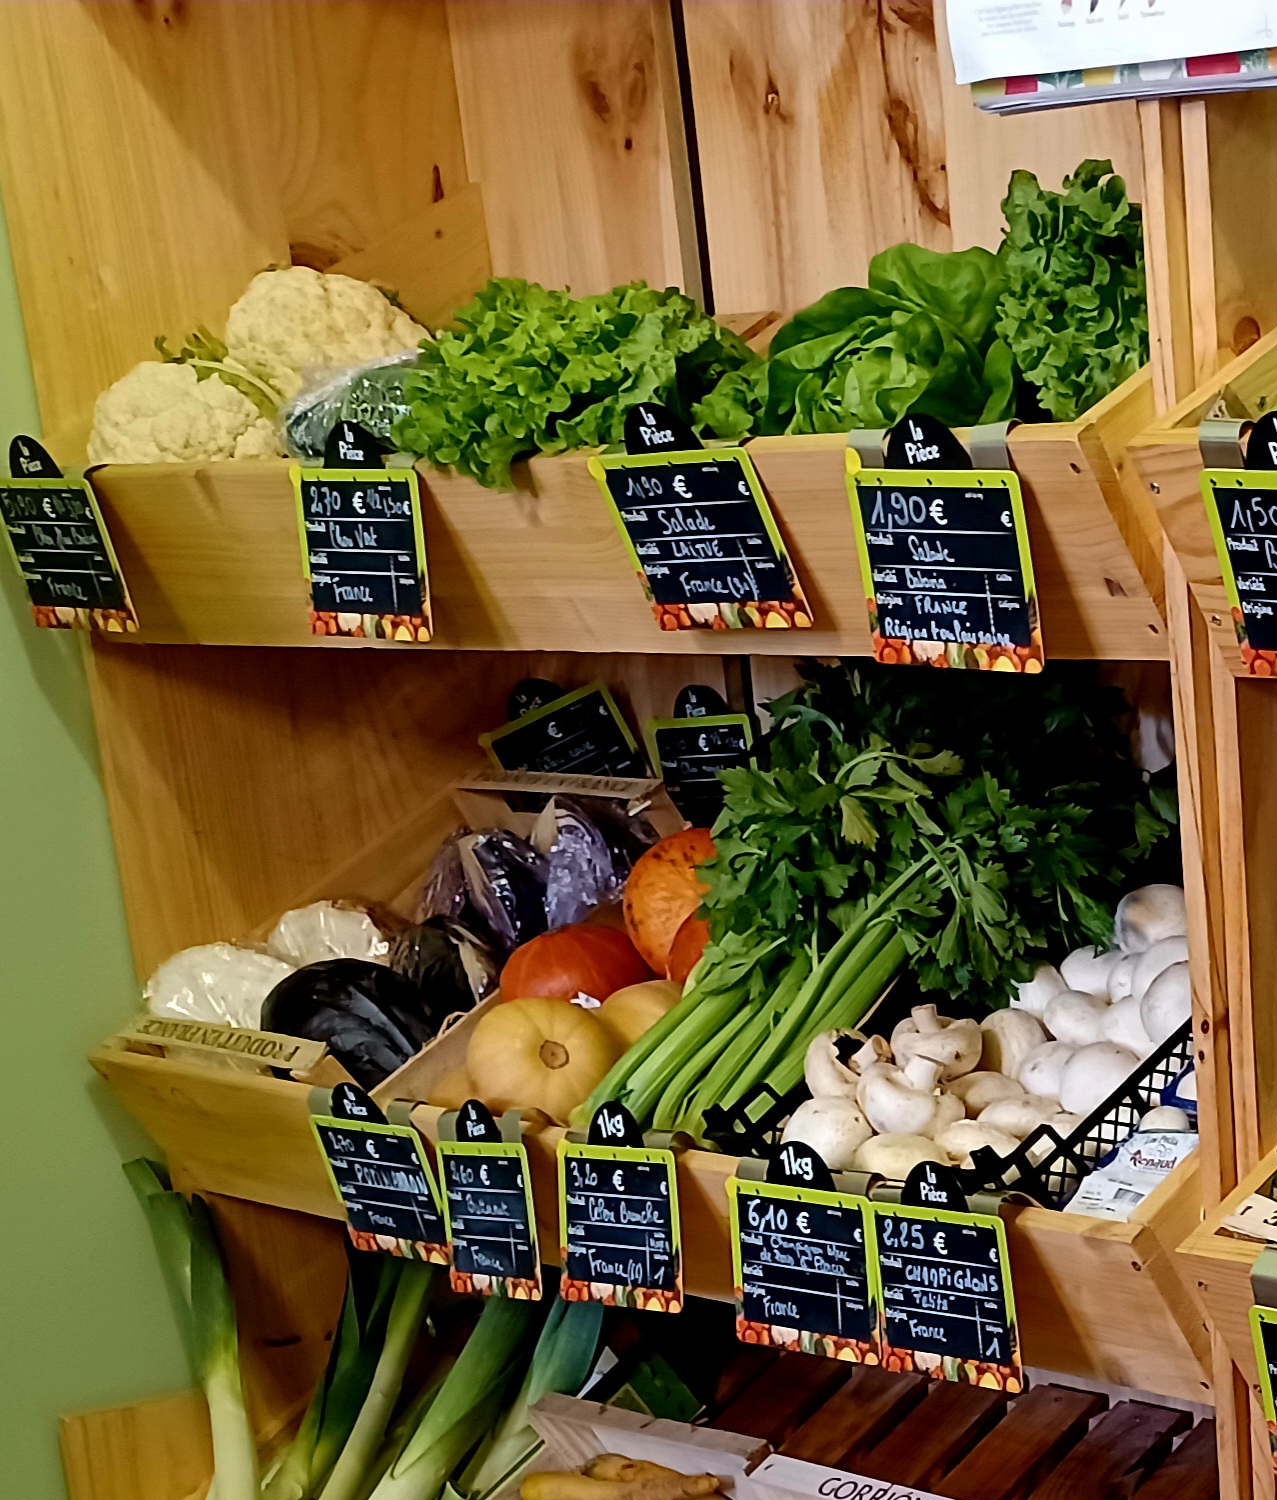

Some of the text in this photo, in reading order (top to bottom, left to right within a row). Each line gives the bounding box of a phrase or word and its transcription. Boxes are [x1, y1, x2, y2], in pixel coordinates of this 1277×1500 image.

[639, 427, 675, 445] Pièce
[905, 442, 940, 464] Pièce
[871, 491, 948, 532] 1,90 €
[597, 1109, 624, 1138] 1kg
[780, 1146, 813, 1180] 1kg
[920, 1182, 947, 1202] Pièce
[747, 1199, 811, 1234] 6,10 €
[883, 1219, 947, 1255] 2,25 €
[764, 1296, 799, 1319] France
[909, 1319, 947, 1342] France
